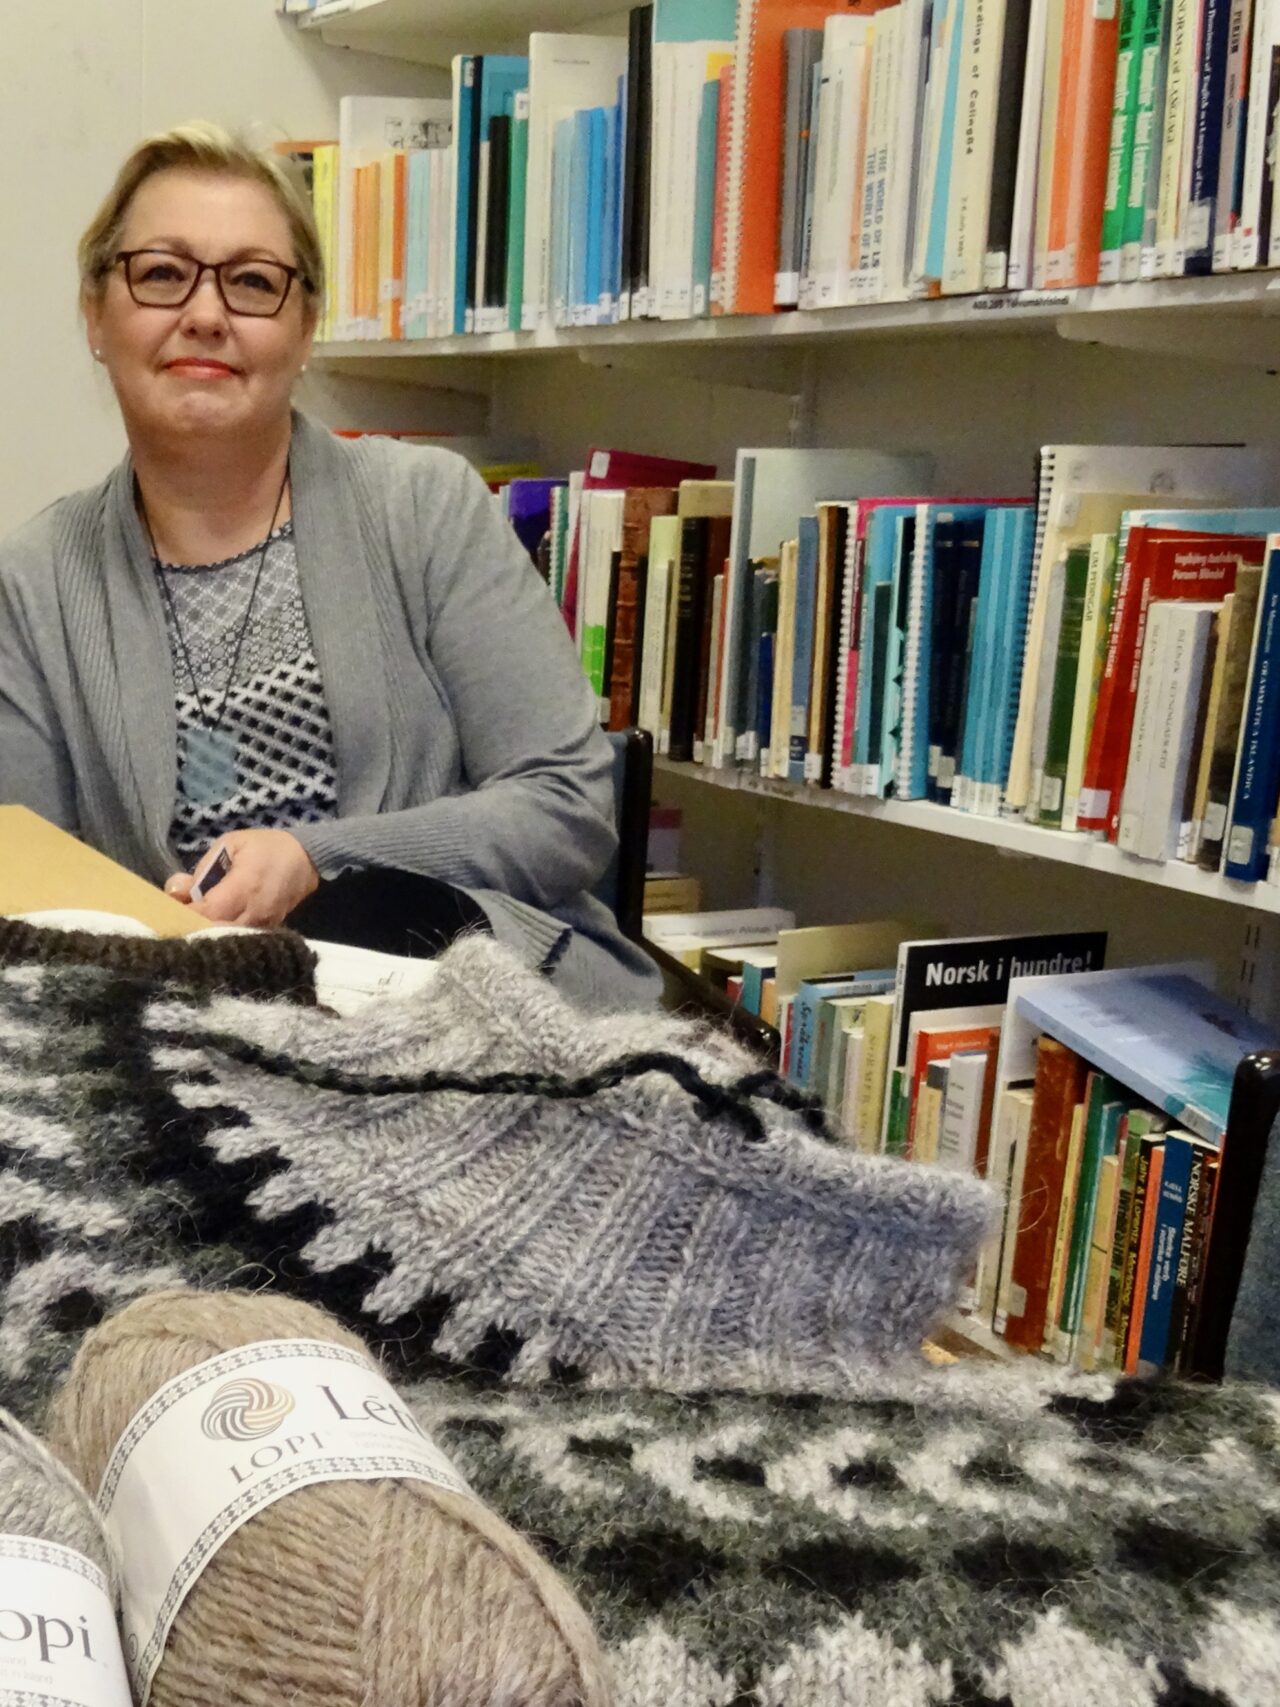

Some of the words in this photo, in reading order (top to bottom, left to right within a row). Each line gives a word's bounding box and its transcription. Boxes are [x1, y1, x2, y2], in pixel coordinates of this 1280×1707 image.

[972, 0, 985, 54] edings
[971, 64, 979, 78] of
[1250, 659, 1270, 737] GRAMMATICA
[1241, 739, 1259, 801] ISLANDICA
[925, 959, 990, 987] Norsk
[996, 957, 1005, 980] i
[1009, 950, 1092, 979] hundre!
[1136, 1154, 1150, 1182] Jahr
[1185, 1160, 1202, 1216] NORSKE
[1129, 1198, 1144, 1244] Lorentz
[229, 1432, 324, 1485] LOPI
